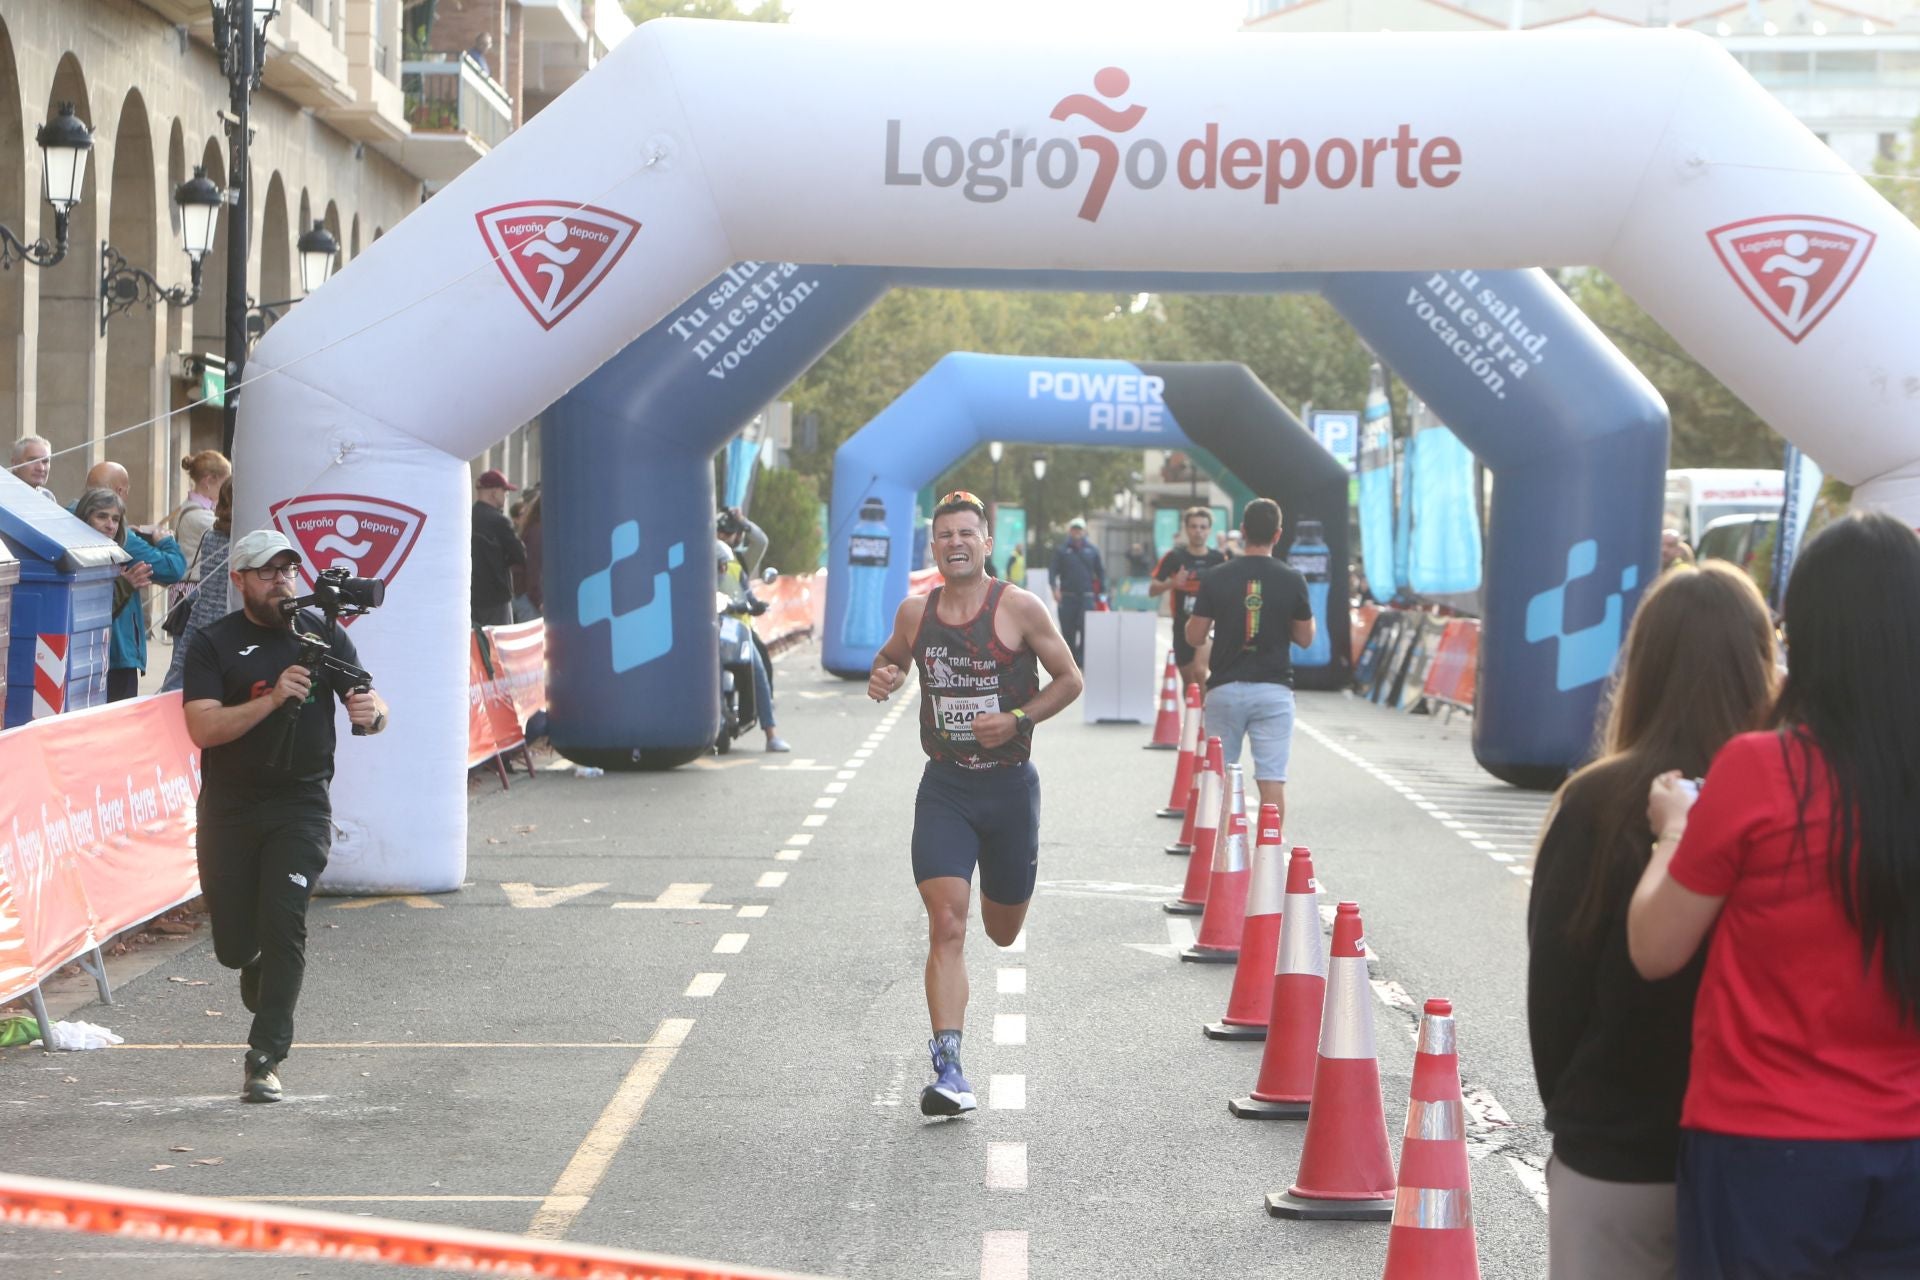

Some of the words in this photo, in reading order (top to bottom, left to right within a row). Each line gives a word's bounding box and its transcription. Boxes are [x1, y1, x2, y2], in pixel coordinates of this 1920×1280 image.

[1176, 122, 1463, 205] deporte
[503, 222, 544, 235] Logroño
[569, 225, 610, 244] deporte
[667, 307, 710, 342] Tu
[708, 260, 766, 311] salu
[692, 261, 799, 362] nuestra
[1450, 269, 1481, 291] u
[1476, 288, 1549, 364] salud,
[706, 279, 820, 380] vocación.
[1405, 285, 1507, 400] vocación.
[1425, 272, 1529, 379] nuestra
[1028, 370, 1166, 404] POWER
[1088, 402, 1165, 432] ADE
[295, 516, 334, 531] Logroño
[360, 518, 400, 536] deporte
[925, 646, 948, 658] BECA
[948, 657, 973, 667] TRAIL
[972, 660, 996, 670] TEAM
[949, 673, 999, 687] Chiruca
[943, 710, 987, 725] 244
